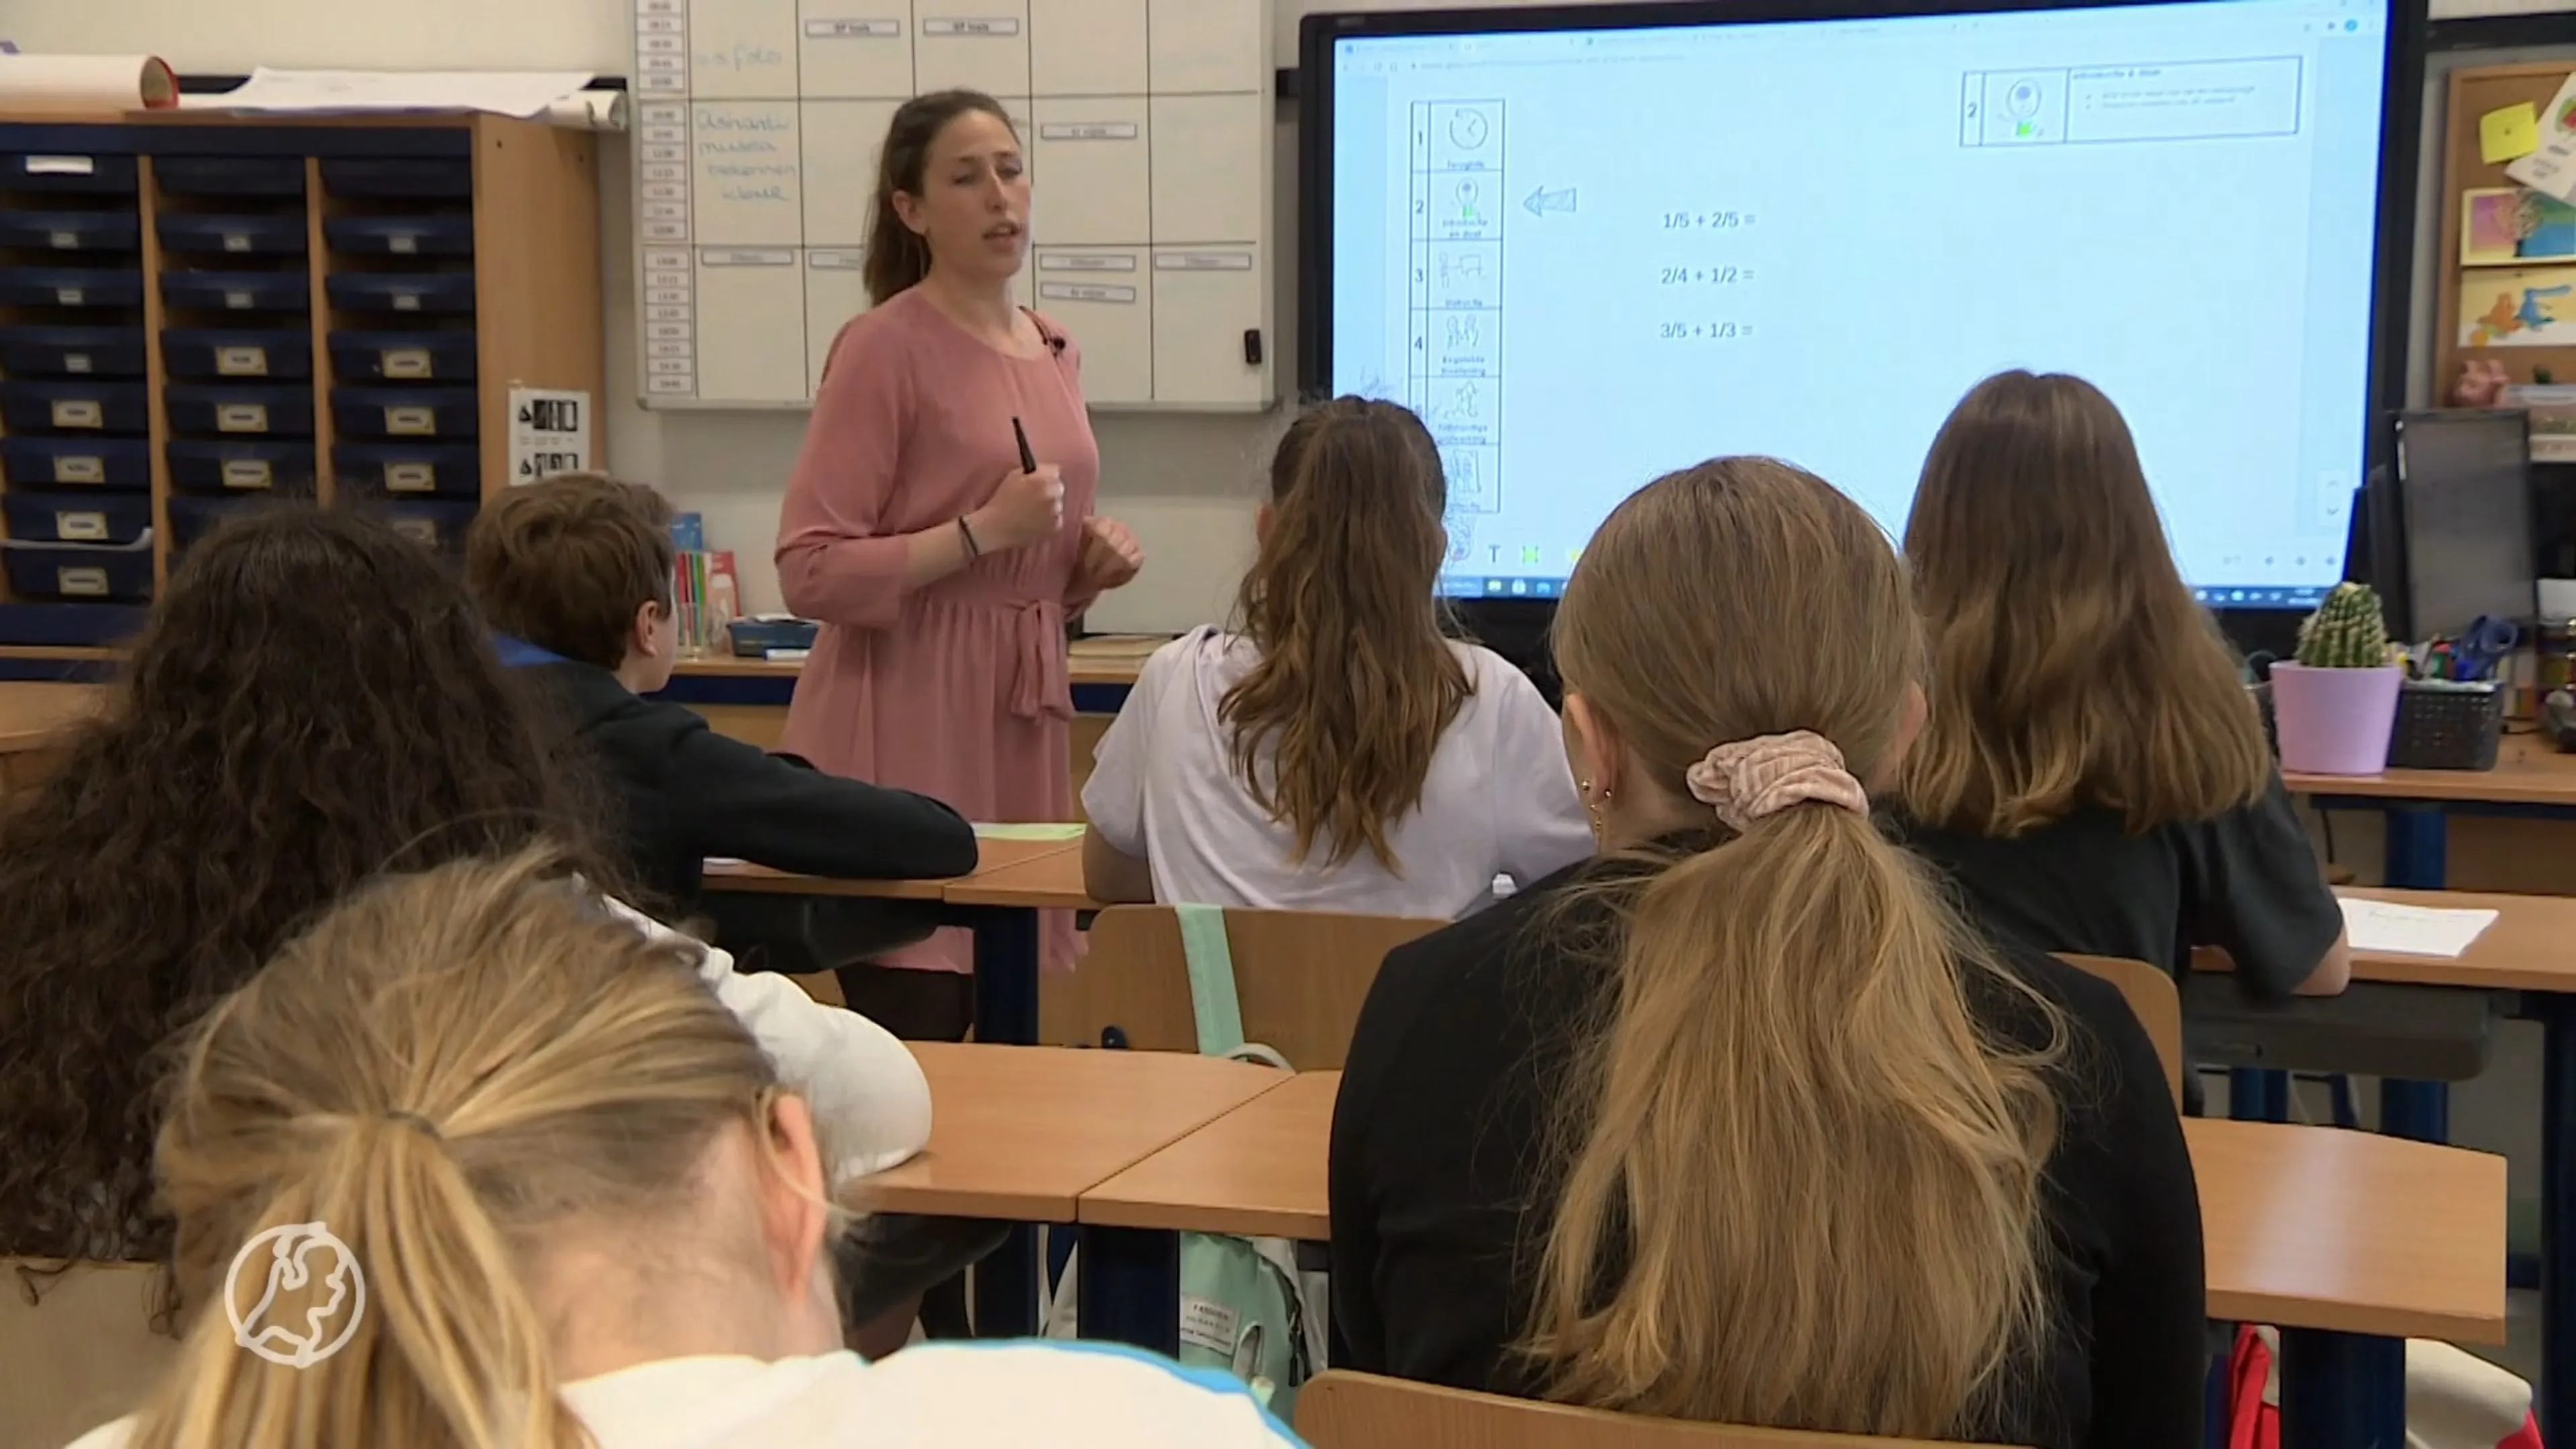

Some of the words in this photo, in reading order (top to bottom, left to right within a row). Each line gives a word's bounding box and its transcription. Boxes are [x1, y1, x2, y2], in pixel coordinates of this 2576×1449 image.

[1968, 102, 1978, 118] 2
[1415, 199, 1424, 214] 2
[1664, 211, 1690, 228] 1/5
[1696, 215, 1706, 226] +
[1712, 211, 1739, 228] 2/5
[1745, 215, 1756, 224] =
[1415, 268, 1424, 283] 3
[1661, 267, 1688, 284] 2/4
[1695, 270, 1705, 281] +
[1712, 266, 1738, 284] 1/2
[1743, 270, 1754, 279] =
[1660, 322, 1687, 338] 3/5
[1693, 325, 1703, 336] +
[1711, 322, 1737, 338] 1/3
[1741, 325, 1753, 335] =
[1414, 336, 1423, 351] 4
